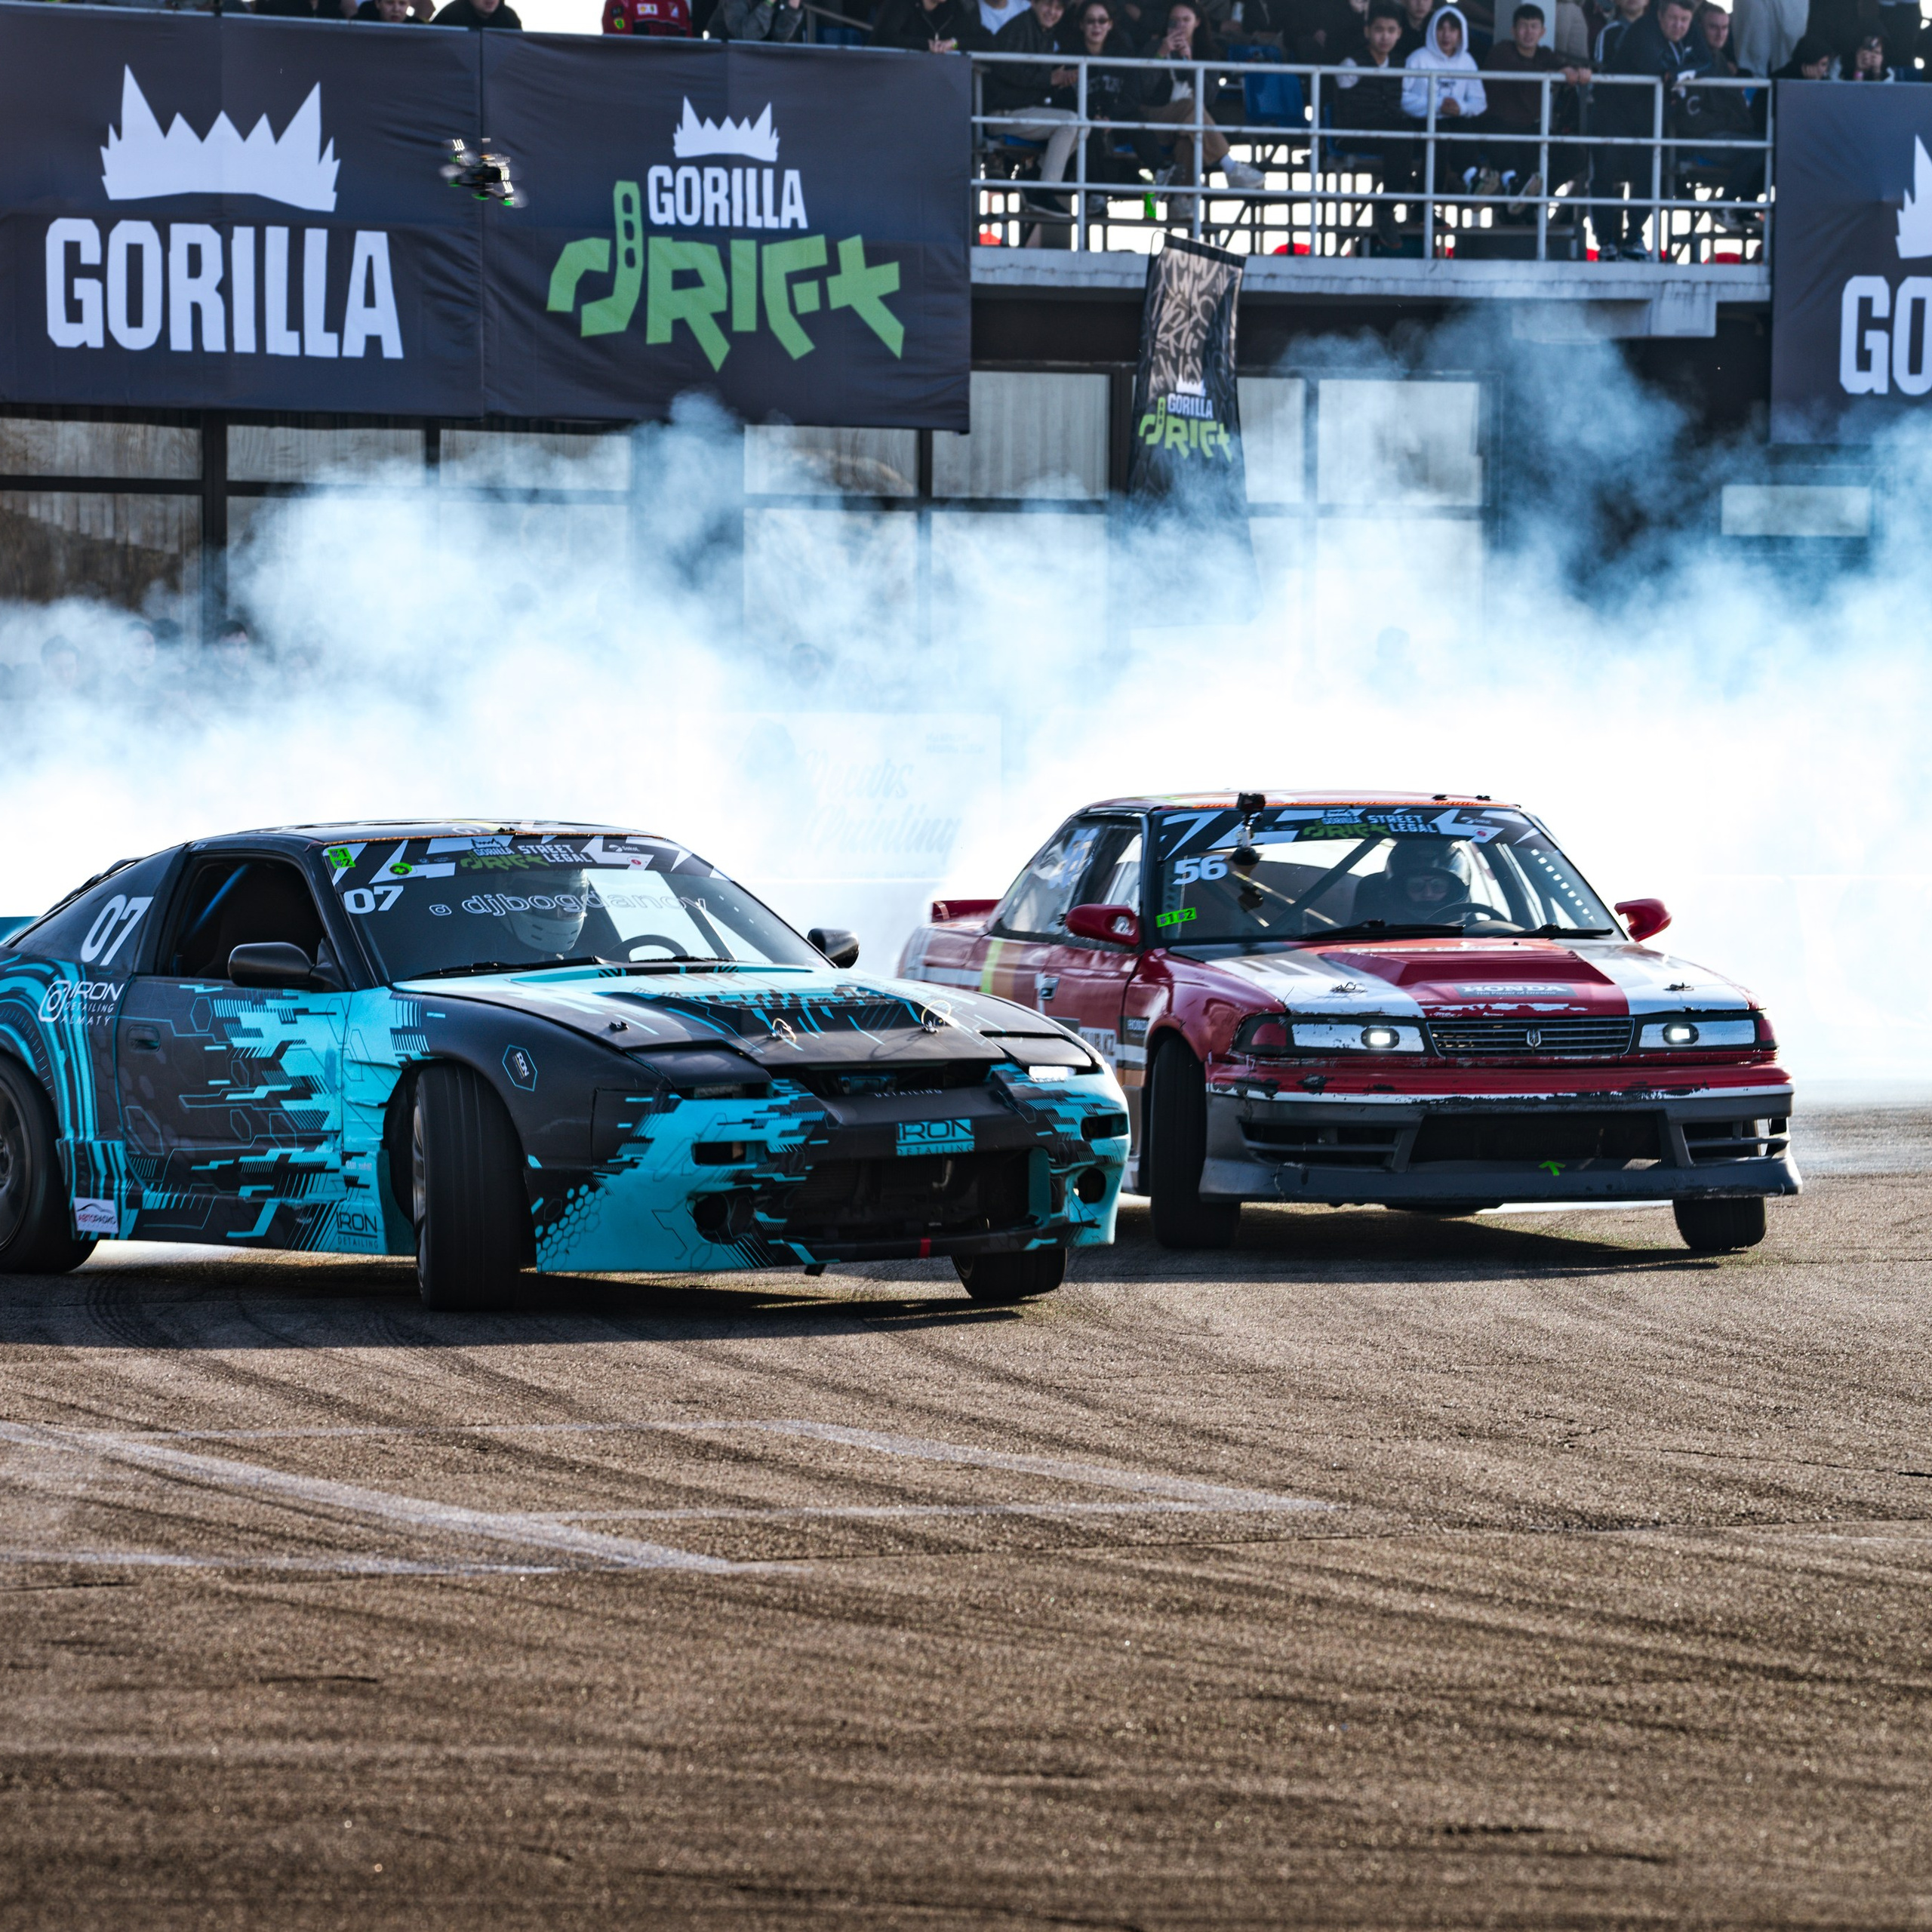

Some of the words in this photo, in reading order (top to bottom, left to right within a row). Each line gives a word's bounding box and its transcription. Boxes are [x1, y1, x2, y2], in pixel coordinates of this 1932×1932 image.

[648, 165, 808, 228] GORILLA
[45, 217, 403, 358] GORILLA
[1168, 392, 1214, 419] GORILLA
[1321, 816, 1362, 825] GORILLA
[1366, 815, 1423, 824] STREET
[1389, 823, 1438, 832] LEGAL
[473, 846, 515, 857] GORILLA
[517, 844, 574, 854] STREET
[543, 854, 593, 863] LEGAL
[1172, 854, 1228, 885] 56
[343, 885, 404, 914] 07
[80, 894, 154, 966] 07
[69, 981, 125, 1001] IRON
[63, 1001, 115, 1013] DETAILING
[60, 1016, 110, 1026] ALMATY
[897, 1120, 974, 1141] IRON
[897, 1143, 974, 1155] DETAILING
[336, 1211, 377, 1233] IRON
[337, 1236, 379, 1249] DETAILING
